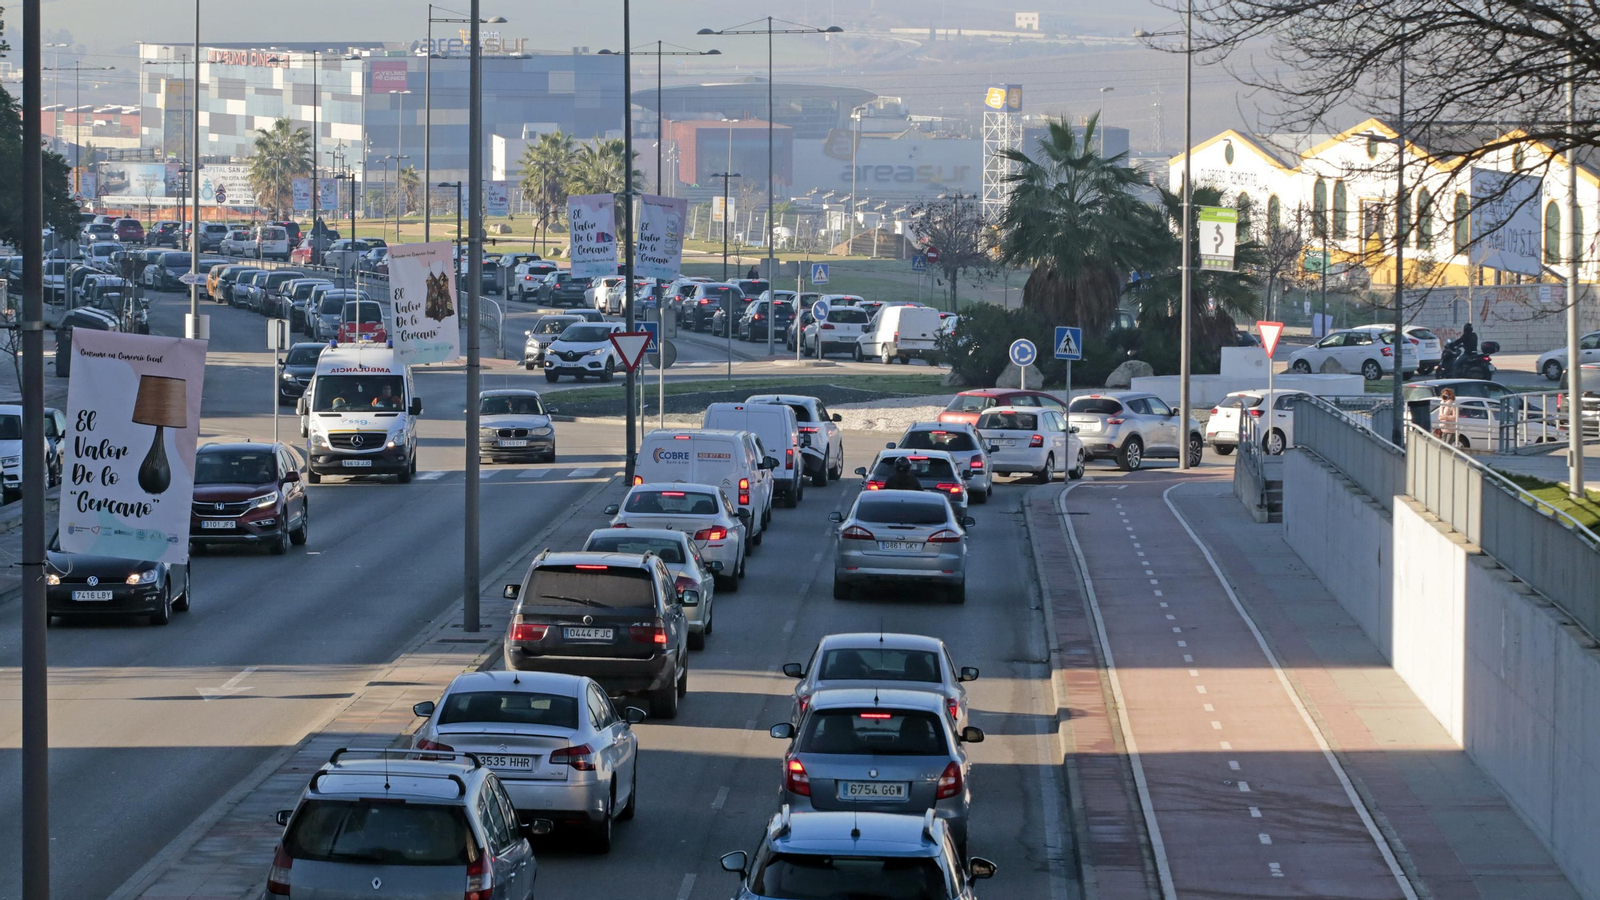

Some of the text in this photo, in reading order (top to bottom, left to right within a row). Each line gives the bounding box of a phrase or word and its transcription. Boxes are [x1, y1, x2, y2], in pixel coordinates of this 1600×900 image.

[217, 50, 248, 66] YELMO
[841, 164, 970, 183] areasur
[573, 209, 582, 220] El
[573, 220, 596, 232] Valor
[641, 222, 650, 232] El
[574, 232, 593, 243] De lo
[640, 232, 661, 242] Valor
[639, 243, 658, 252] De lo
[394, 287, 405, 301] El
[395, 300, 421, 315] Valor
[396, 314, 420, 329] De lo
[80, 348, 107, 358] Consume
[118, 351, 144, 362] Comercio
[75, 409, 97, 432] El
[74, 435, 129, 461] Valor
[658, 451, 690, 460] COBRE
[72, 463, 120, 487] De lo
[76, 591, 96, 599] 7416
[569, 628, 611, 638] 0444 FJC
[480, 756, 530, 768] 3535 HHR
[850, 784, 903, 796] 6754 GGW
